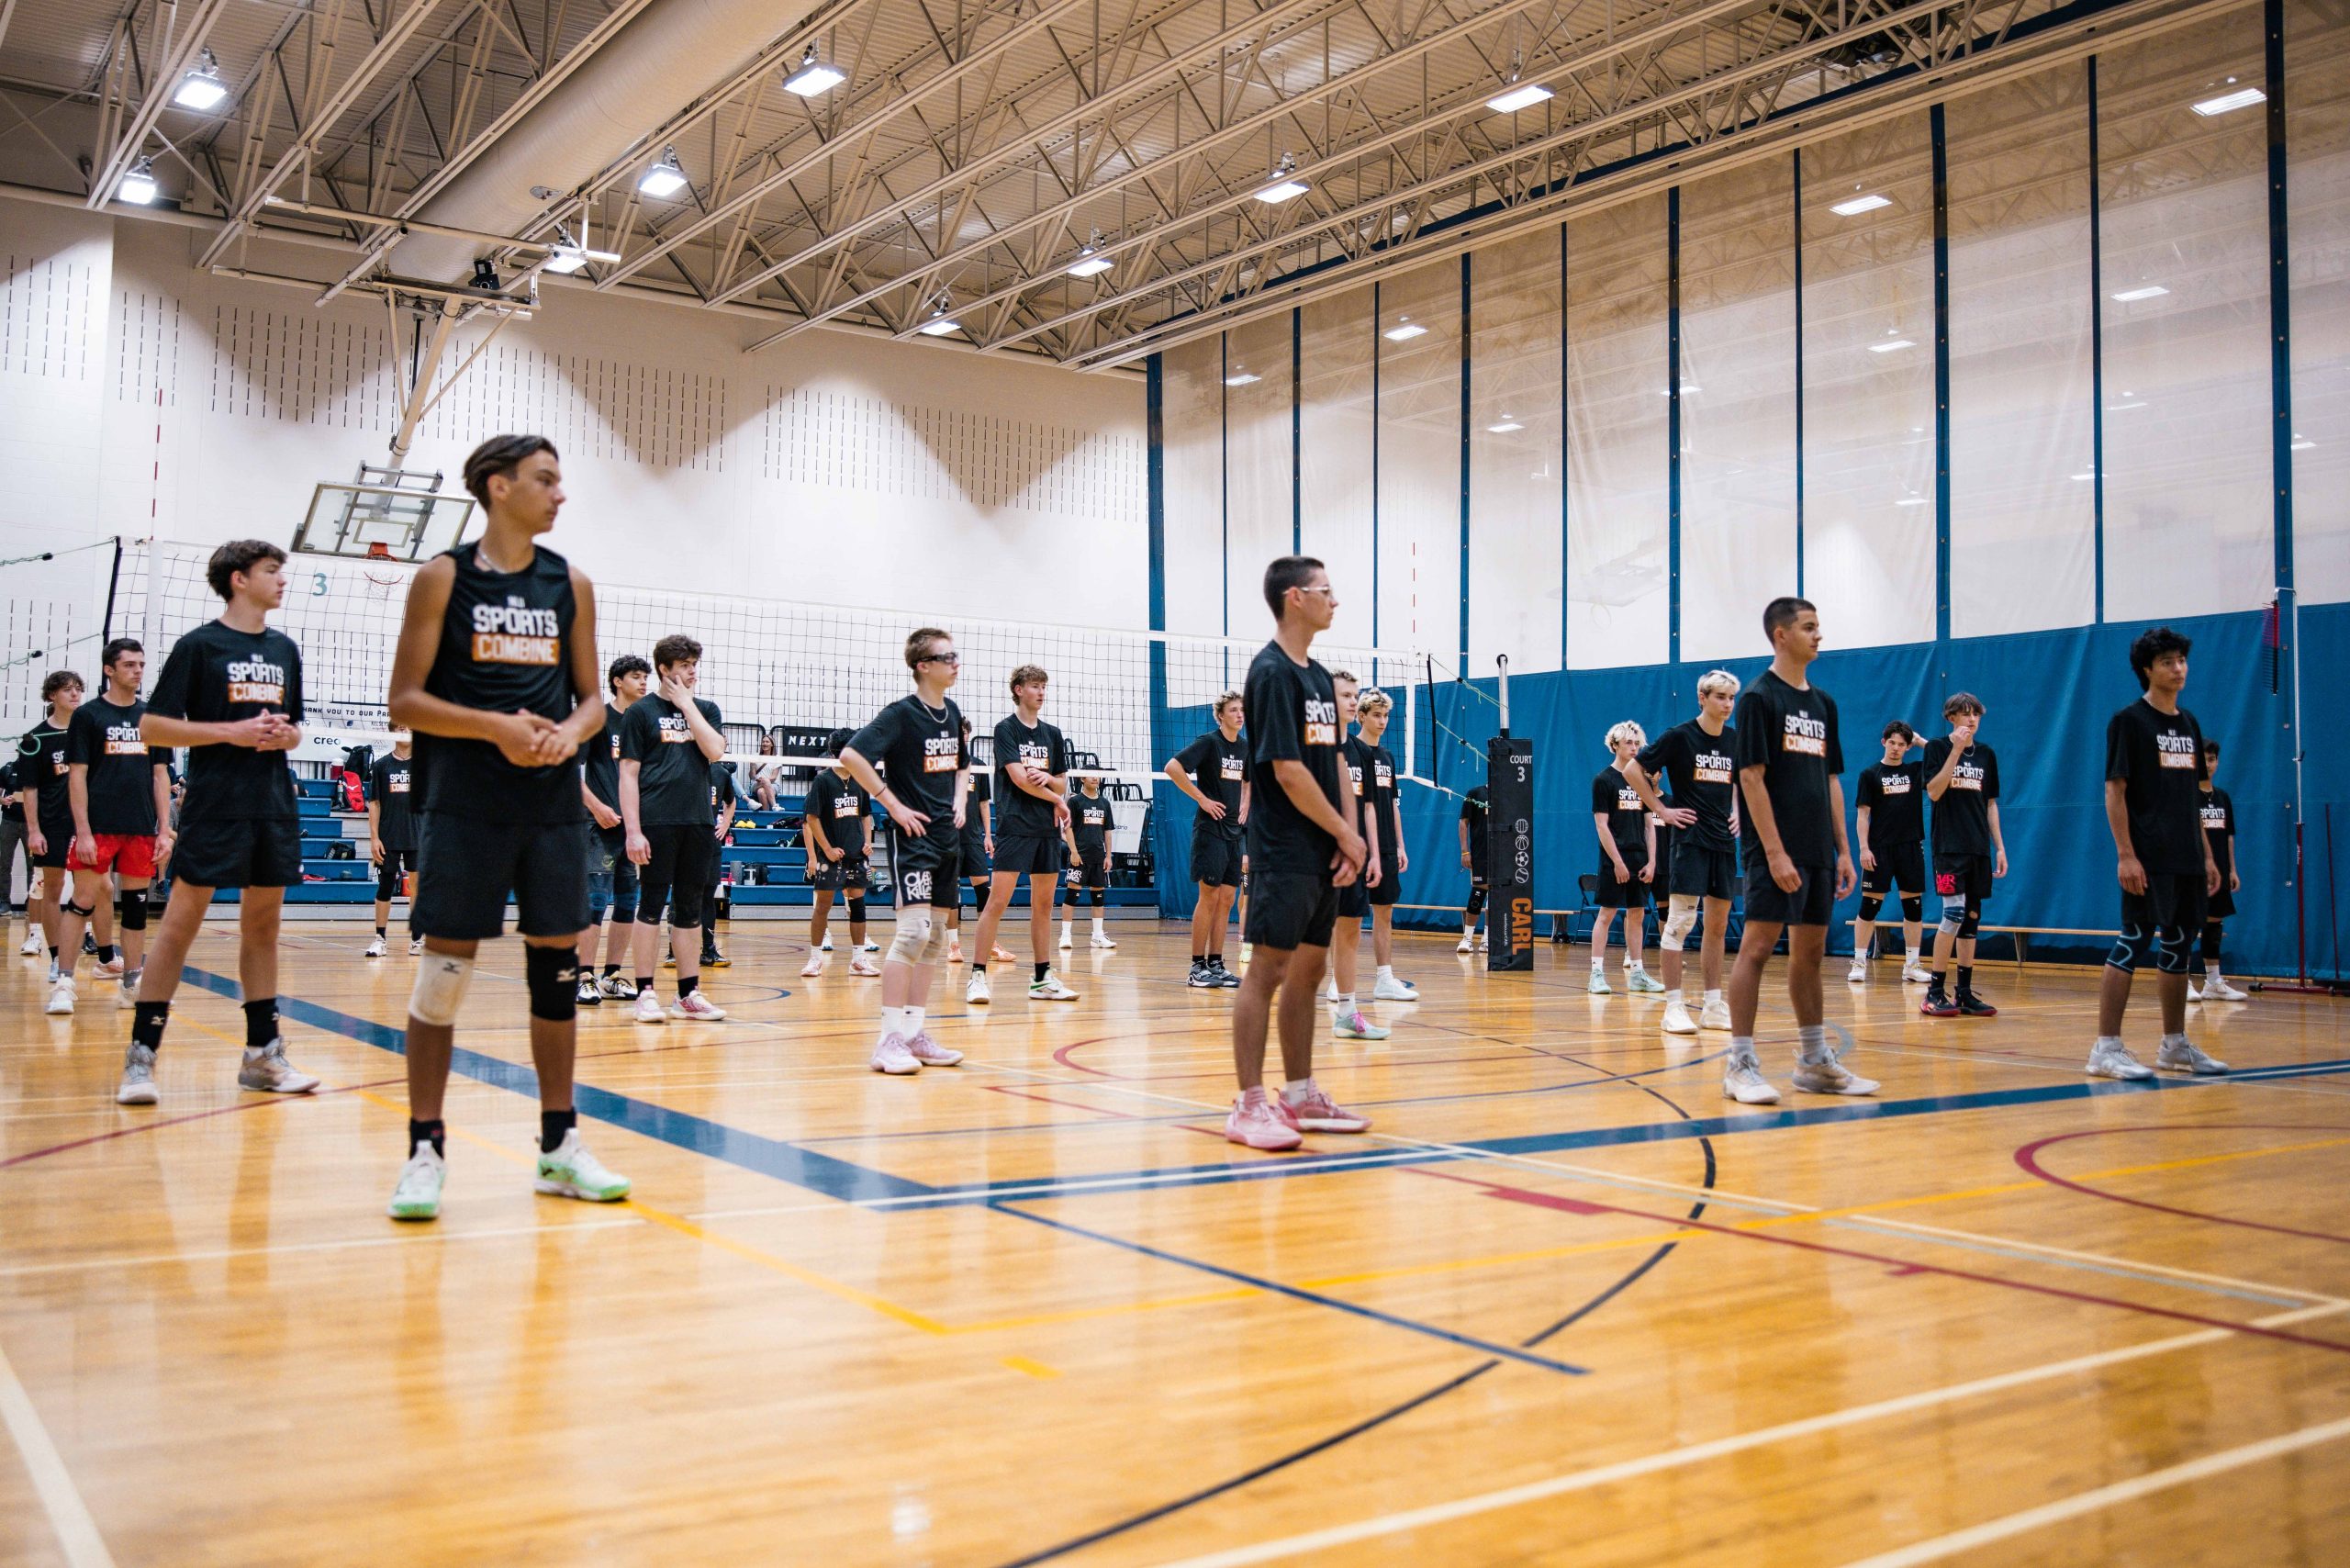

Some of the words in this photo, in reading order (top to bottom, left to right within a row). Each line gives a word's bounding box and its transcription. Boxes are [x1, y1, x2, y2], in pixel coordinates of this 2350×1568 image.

[313, 572, 328, 597] 3
[473, 604, 560, 637] SPORTS
[477, 634, 557, 663] COMBINE
[227, 662, 285, 686] SPORTS
[106, 726, 141, 741] SPORT
[1784, 714, 1826, 740] SPORTS
[788, 735, 827, 746] NEXT
[924, 737, 959, 756] SPORTS
[1785, 734, 1826, 758] COMBINE
[2156, 734, 2195, 753] SPORTS
[1222, 757, 1243, 771] SPORTS
[1509, 755, 1533, 765] COURT
[1695, 754, 1732, 771] SPORTS
[2160, 752, 2195, 769] COMBINE
[389, 774, 410, 783] SPOR
[1516, 766, 1526, 783] 3
[1695, 768, 1730, 784] COMBINE
[1882, 776, 1910, 786] SPORTS
[1511, 897, 1532, 956] CARL
